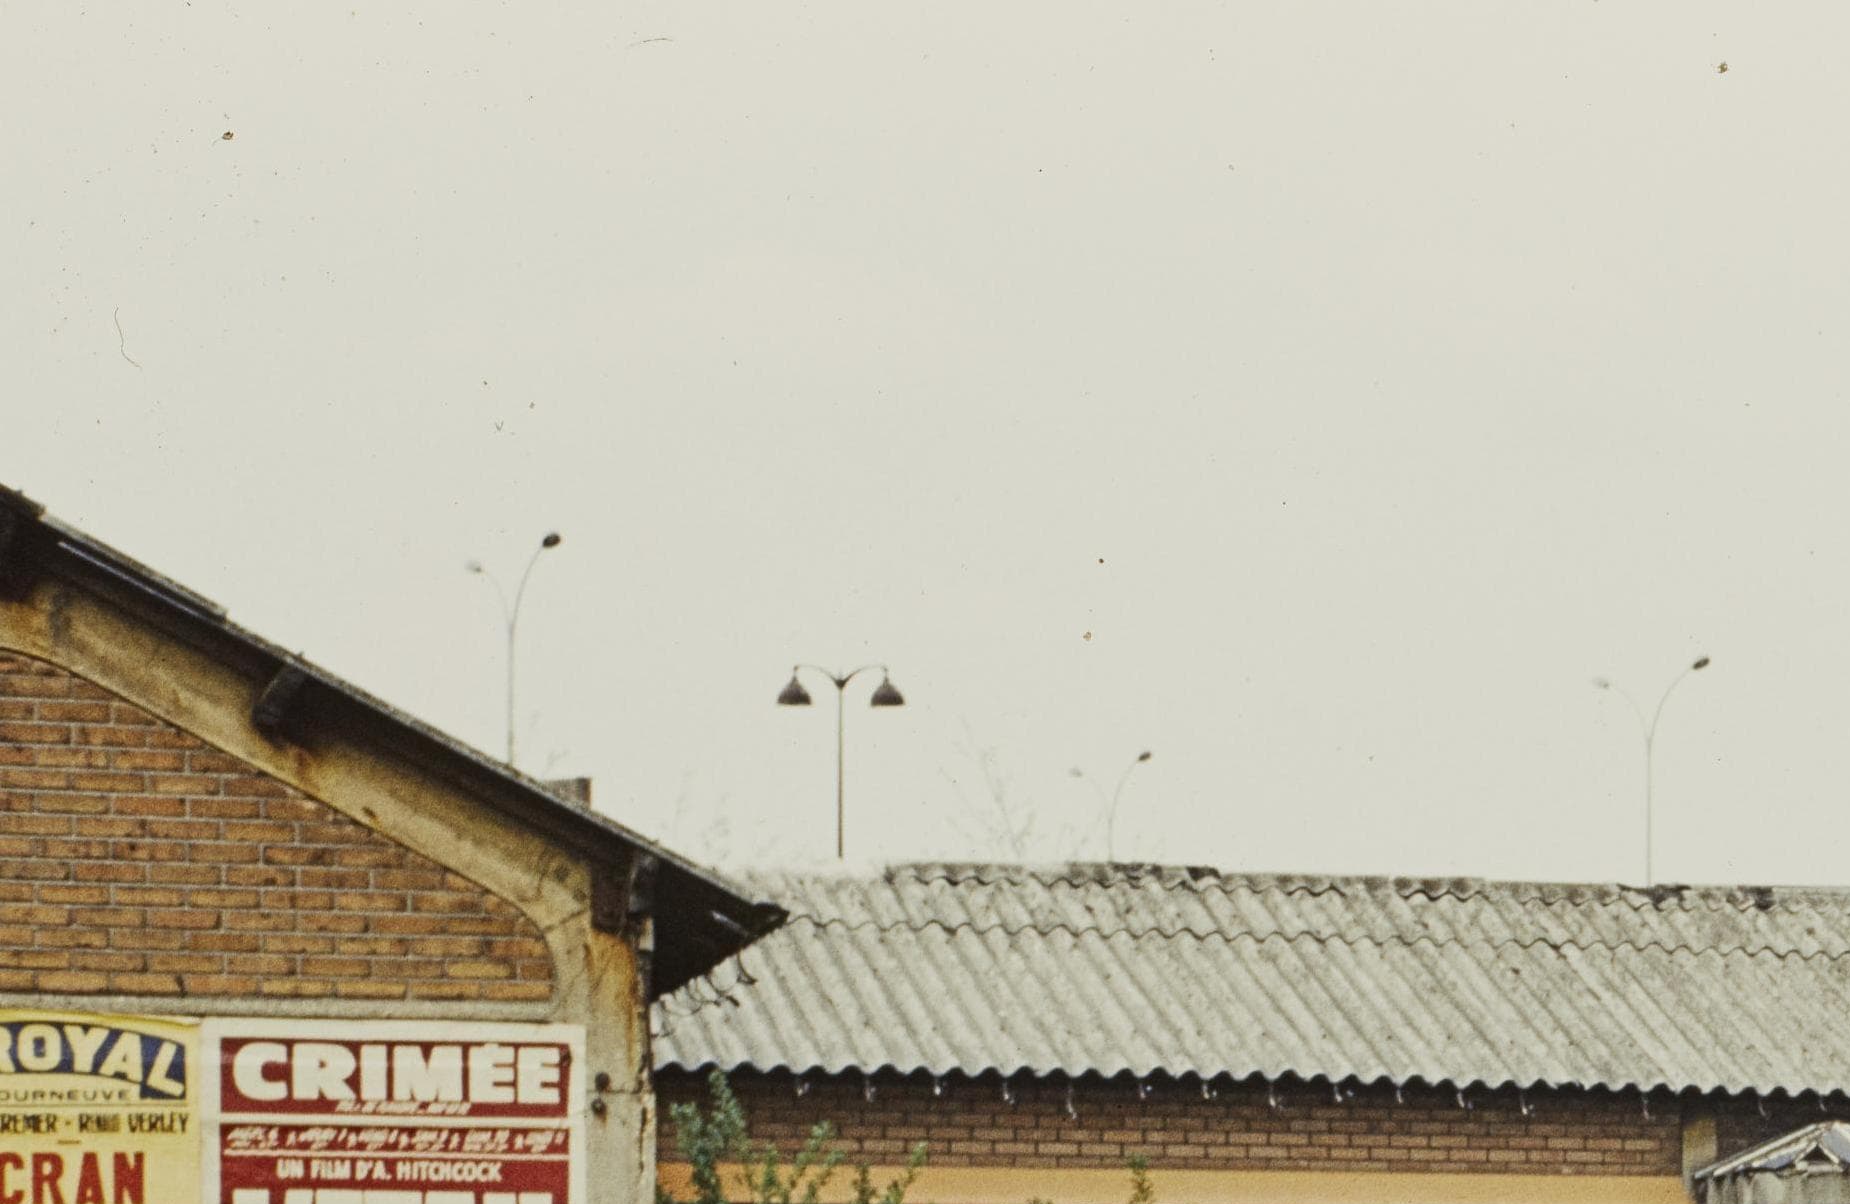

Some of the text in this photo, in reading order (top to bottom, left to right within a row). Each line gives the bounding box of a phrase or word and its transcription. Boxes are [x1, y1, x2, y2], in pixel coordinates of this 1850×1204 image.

[276, 1158, 304, 1179] UN
[310, 1158, 351, 1180] FILM
[397, 1160, 502, 1182] HITCHCOCK
